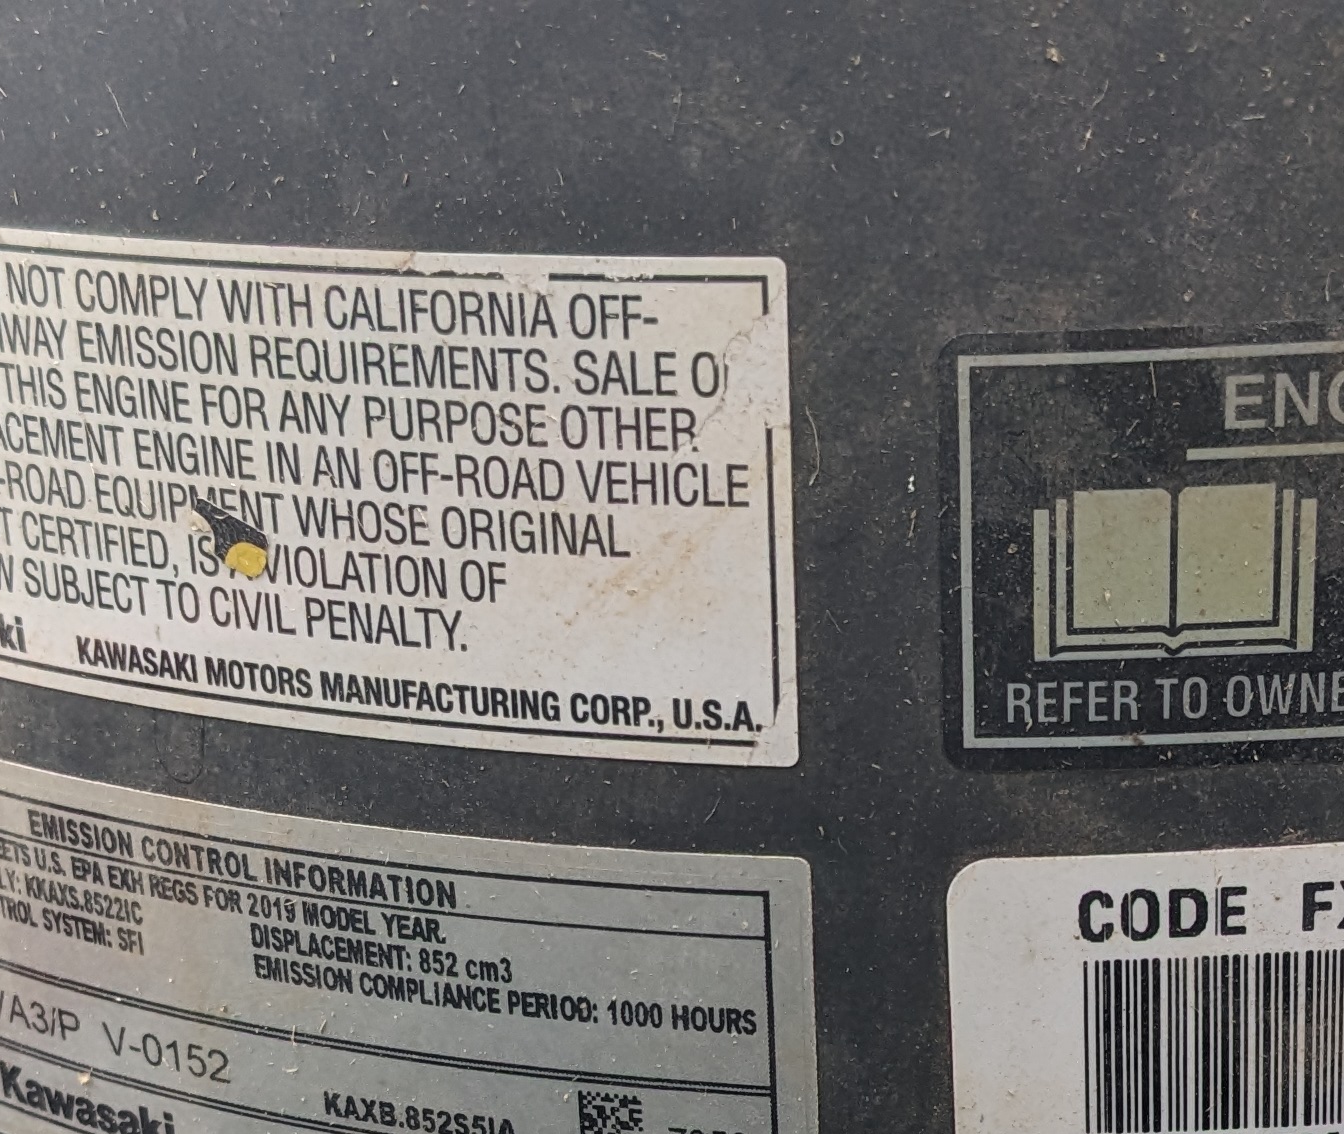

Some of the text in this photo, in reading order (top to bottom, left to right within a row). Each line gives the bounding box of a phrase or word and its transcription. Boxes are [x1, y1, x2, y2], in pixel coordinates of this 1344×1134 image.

[6, 262, 64, 308] NOT
[76, 269, 207, 320] COMPLY
[218, 280, 313, 328] WITH
[324, 285, 557, 339] CALIFORNIA
[568, 293, 658, 340] OFF-
[78, 321, 238, 375] EMISSION
[250, 335, 560, 394] REQUIREMENTS.
[574, 350, 677, 397] SALE
[75, 374, 192, 423] ENGINE
[201, 384, 268, 431] FOR
[280, 394, 349, 437] ANY
[364, 399, 549, 447] PURPOSE
[561, 405, 699, 452] OTHER
[135, 428, 257, 481] ENGINE
[266, 440, 301, 486] IN
[313, 445, 361, 490] AN
[373, 449, 565, 503] OFF-ROAD
[576, 459, 751, 508] VEHICLE
[21, 510, 180, 578] CERTIFIED,
[188, 533, 219, 577] IS
[265, 543, 447, 598] VIOLATION
[460, 559, 507, 602] OF
[292, 495, 431, 547] WHOSE
[442, 505, 631, 558] ORIGINAL
[24, 558, 149, 617] SUBJECT
[156, 579, 200, 623] TO
[210, 586, 297, 635] CIVIL
[305, 598, 468, 651] PENALTY.
[76, 634, 763, 732] KAWASAKI MOTORS MANUFACTURING CORP., U.S.A.
[1006, 680, 1138, 723] REFER
[1155, 676, 1208, 719] TO
[27, 808, 457, 909] EMISSION CONTROL INFORMATION
[34, 847, 67, 876] U.S.
[71, 856, 104, 886] EPA
[107, 864, 145, 896] EXH
[149, 873, 199, 906] REGS
[202, 884, 243, 914] FOR
[246, 893, 295, 923] 2019
[302, 901, 376, 938] MODEL
[381, 910, 446, 945] YEAR.
[42, 906, 113, 948] SYSTEM:
[117, 927, 144, 956] SFI
[250, 923, 513, 984] DISPLACEMENT: 852 cm3
[1078, 886, 1249, 943] CODE
[253, 954, 757, 1036] EMISSION COMPLIANCE PERIOD: 1000 HOURS
[102, 1019, 232, 1084] V-0152
